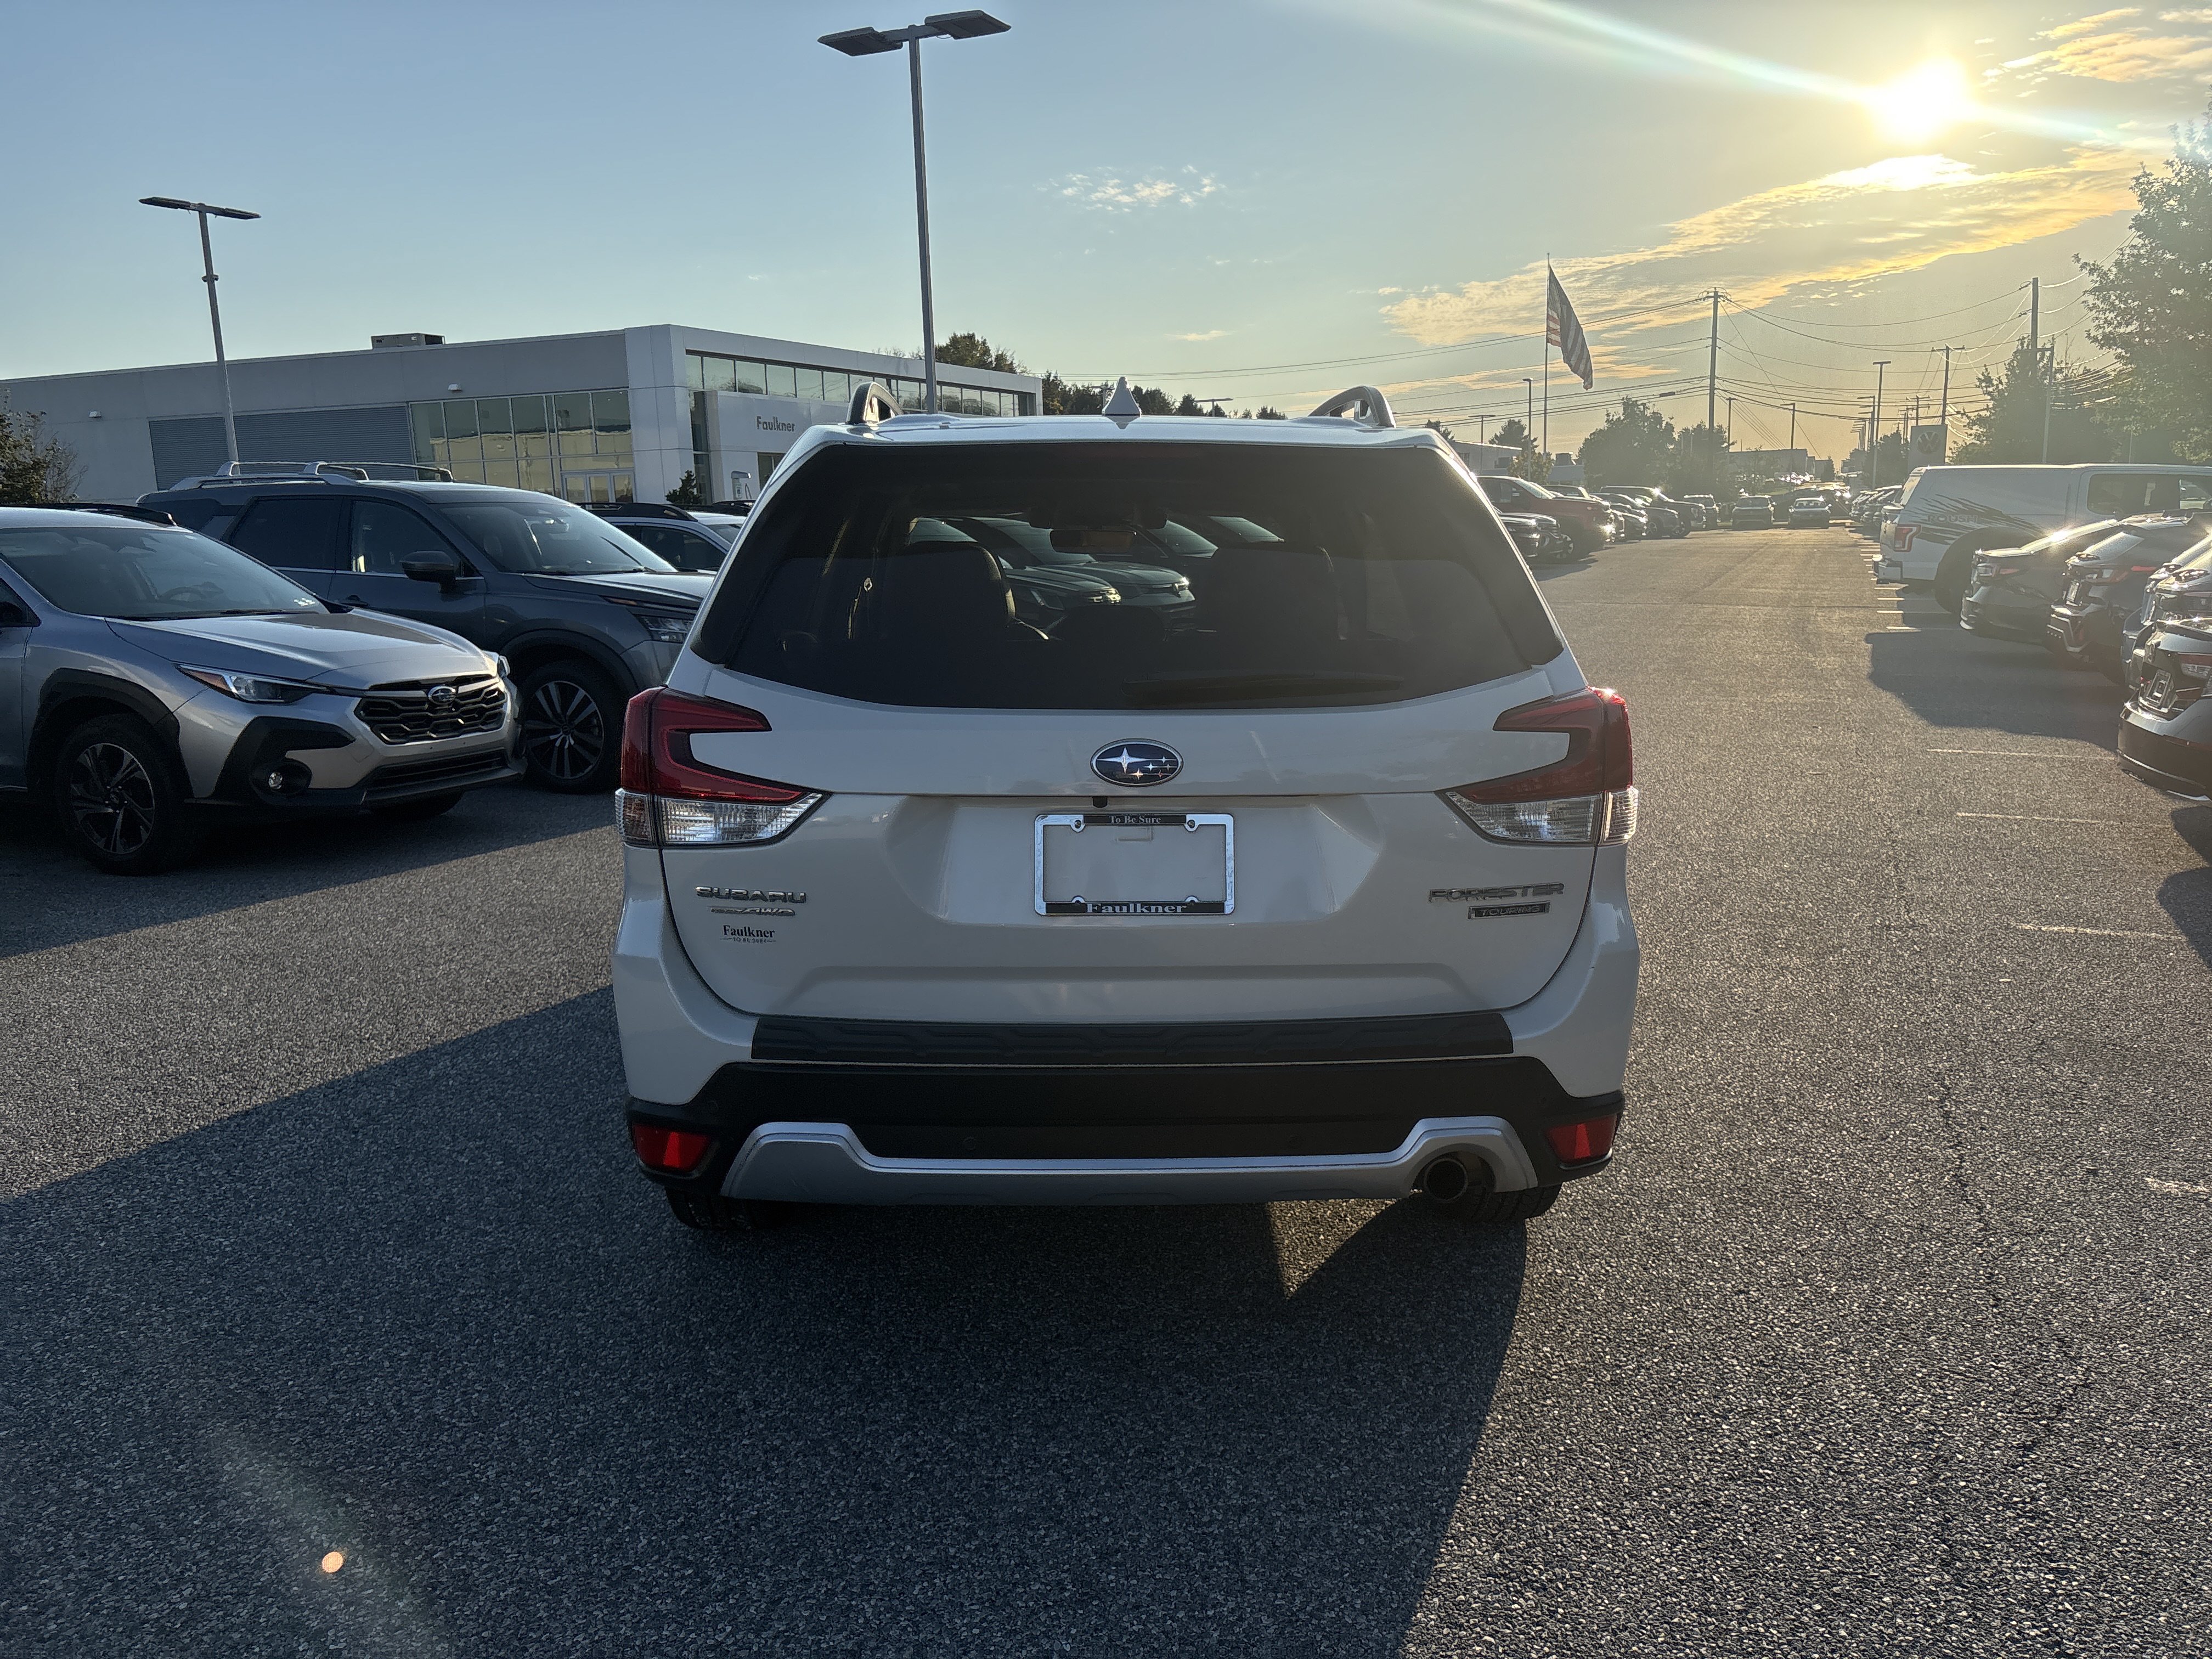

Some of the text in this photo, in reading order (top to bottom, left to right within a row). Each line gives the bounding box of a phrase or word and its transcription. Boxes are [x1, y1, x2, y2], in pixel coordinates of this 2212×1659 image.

[756, 416, 795, 432] Faulkner
[1927, 515, 1978, 523] ROUSH
[695, 886, 807, 904] SUBARU
[1429, 882, 1565, 904] FORESTER
[1085, 903, 1187, 913] Faulkner
[1479, 905, 1541, 916] TOURING
[723, 925, 775, 938] Faulkner
